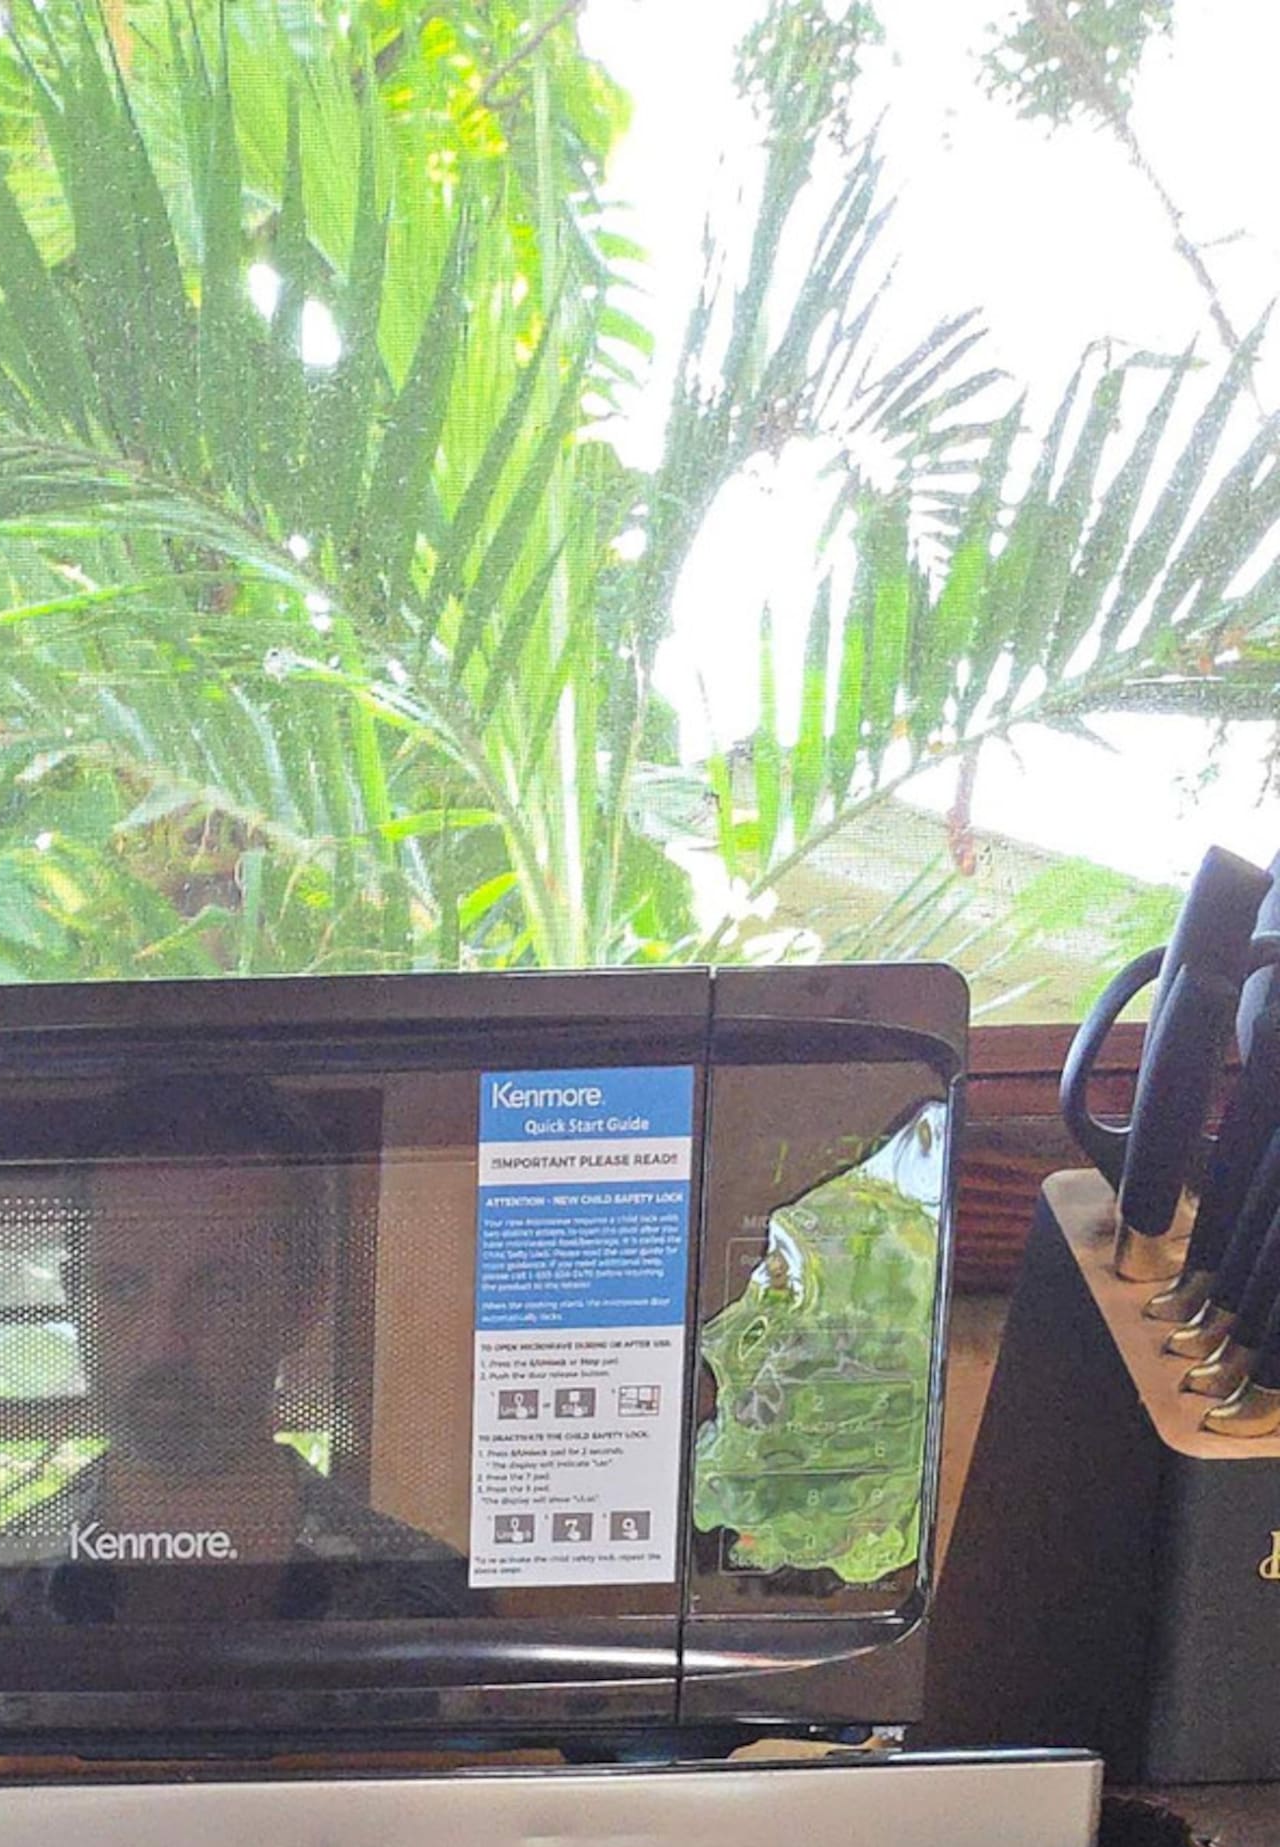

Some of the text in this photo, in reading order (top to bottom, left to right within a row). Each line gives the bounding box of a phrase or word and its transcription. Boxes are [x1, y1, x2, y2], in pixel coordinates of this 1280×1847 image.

[491, 1078, 602, 1109] Kenmore
[524, 1115, 649, 1134] Quick Start Guide
[579, 1154, 629, 1167] PLEASE
[486, 1196, 544, 1208] ATTENTION
[553, 1195, 578, 1206] NEW
[580, 1194, 611, 1205] CHILD
[614, 1192, 653, 1204] SAFETY
[656, 1191, 683, 1202] LOCK
